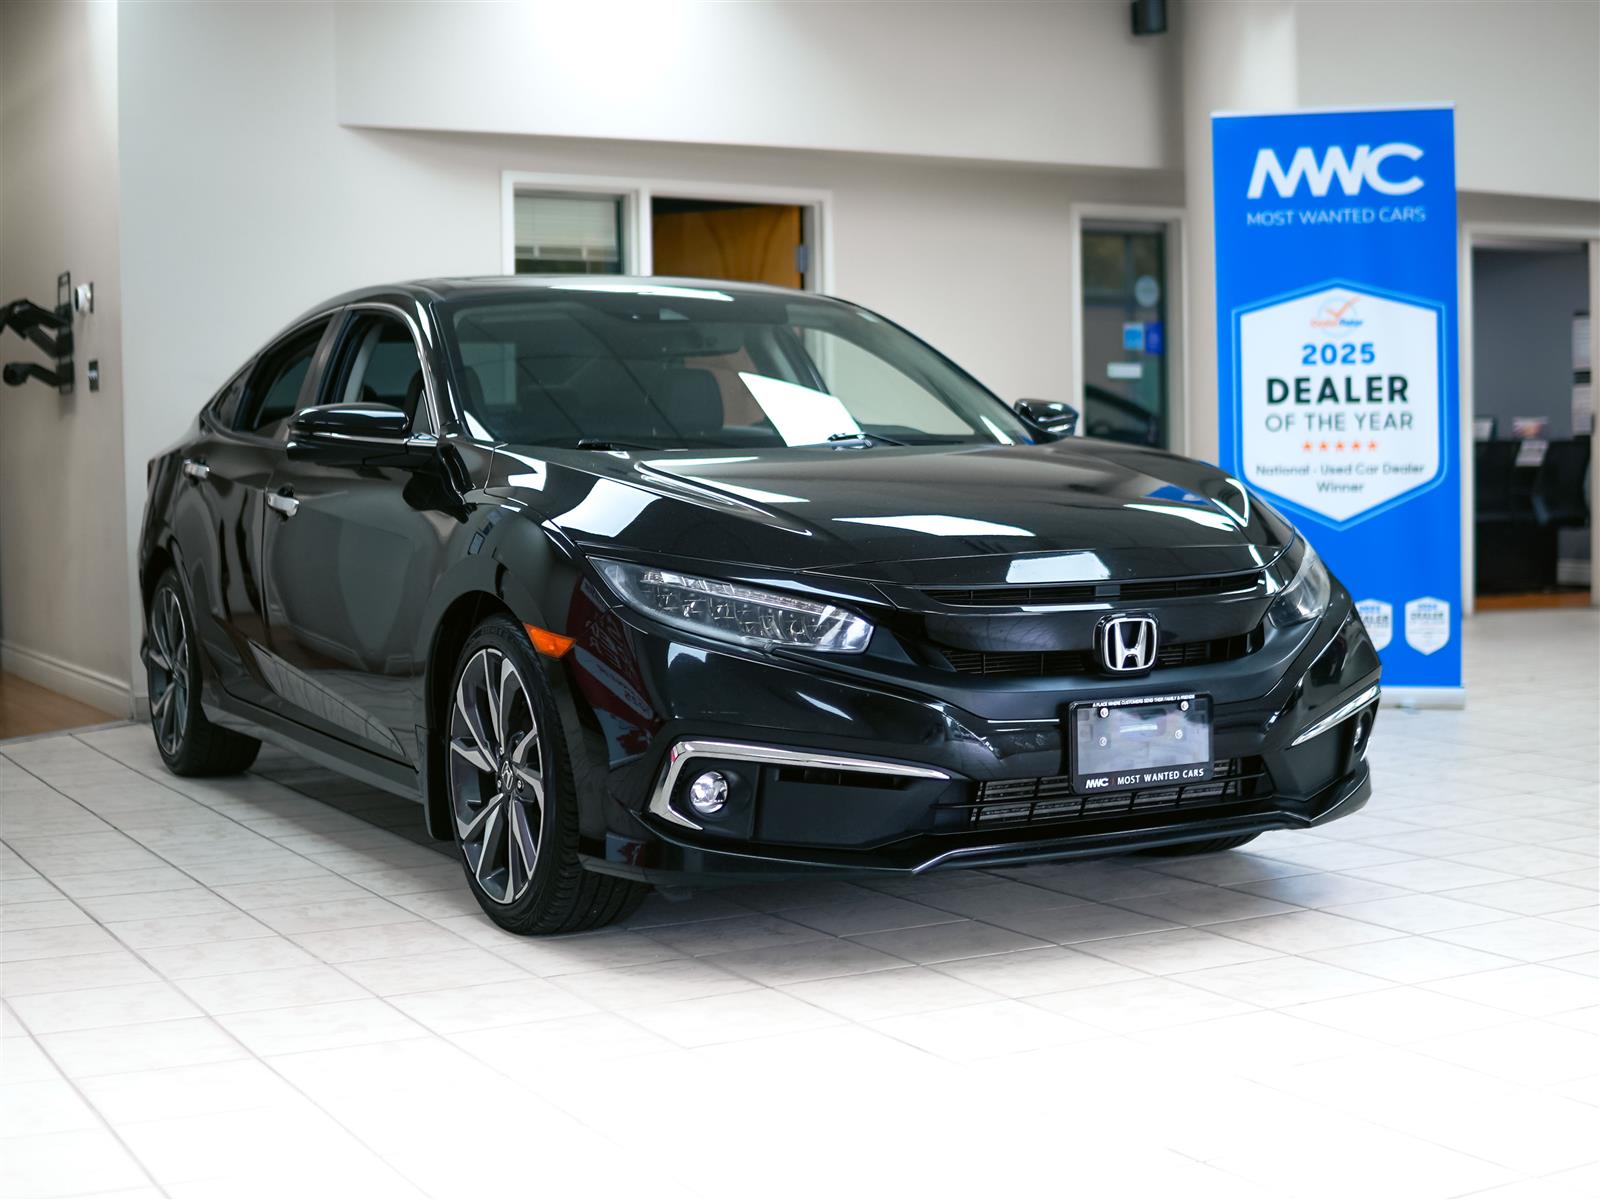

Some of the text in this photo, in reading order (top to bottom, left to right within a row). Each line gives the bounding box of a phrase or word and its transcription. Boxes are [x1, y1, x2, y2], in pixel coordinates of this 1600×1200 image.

[1247, 142, 1424, 199] MWC
[1246, 205, 1426, 226] MOST WANTED CARS
[1301, 343, 1376, 366] 2025
[1266, 376, 1409, 405] DEALER
[1265, 411, 1413, 433] OF THE YEAR
[1255, 464, 1310, 476] National
[1320, 463, 1352, 475] Used
[1356, 462, 1379, 475] Car
[1382, 461, 1424, 475] Dealer
[1316, 480, 1364, 493] Winner
[1085, 768, 1204, 789] MWC MOST WANTED CARS
